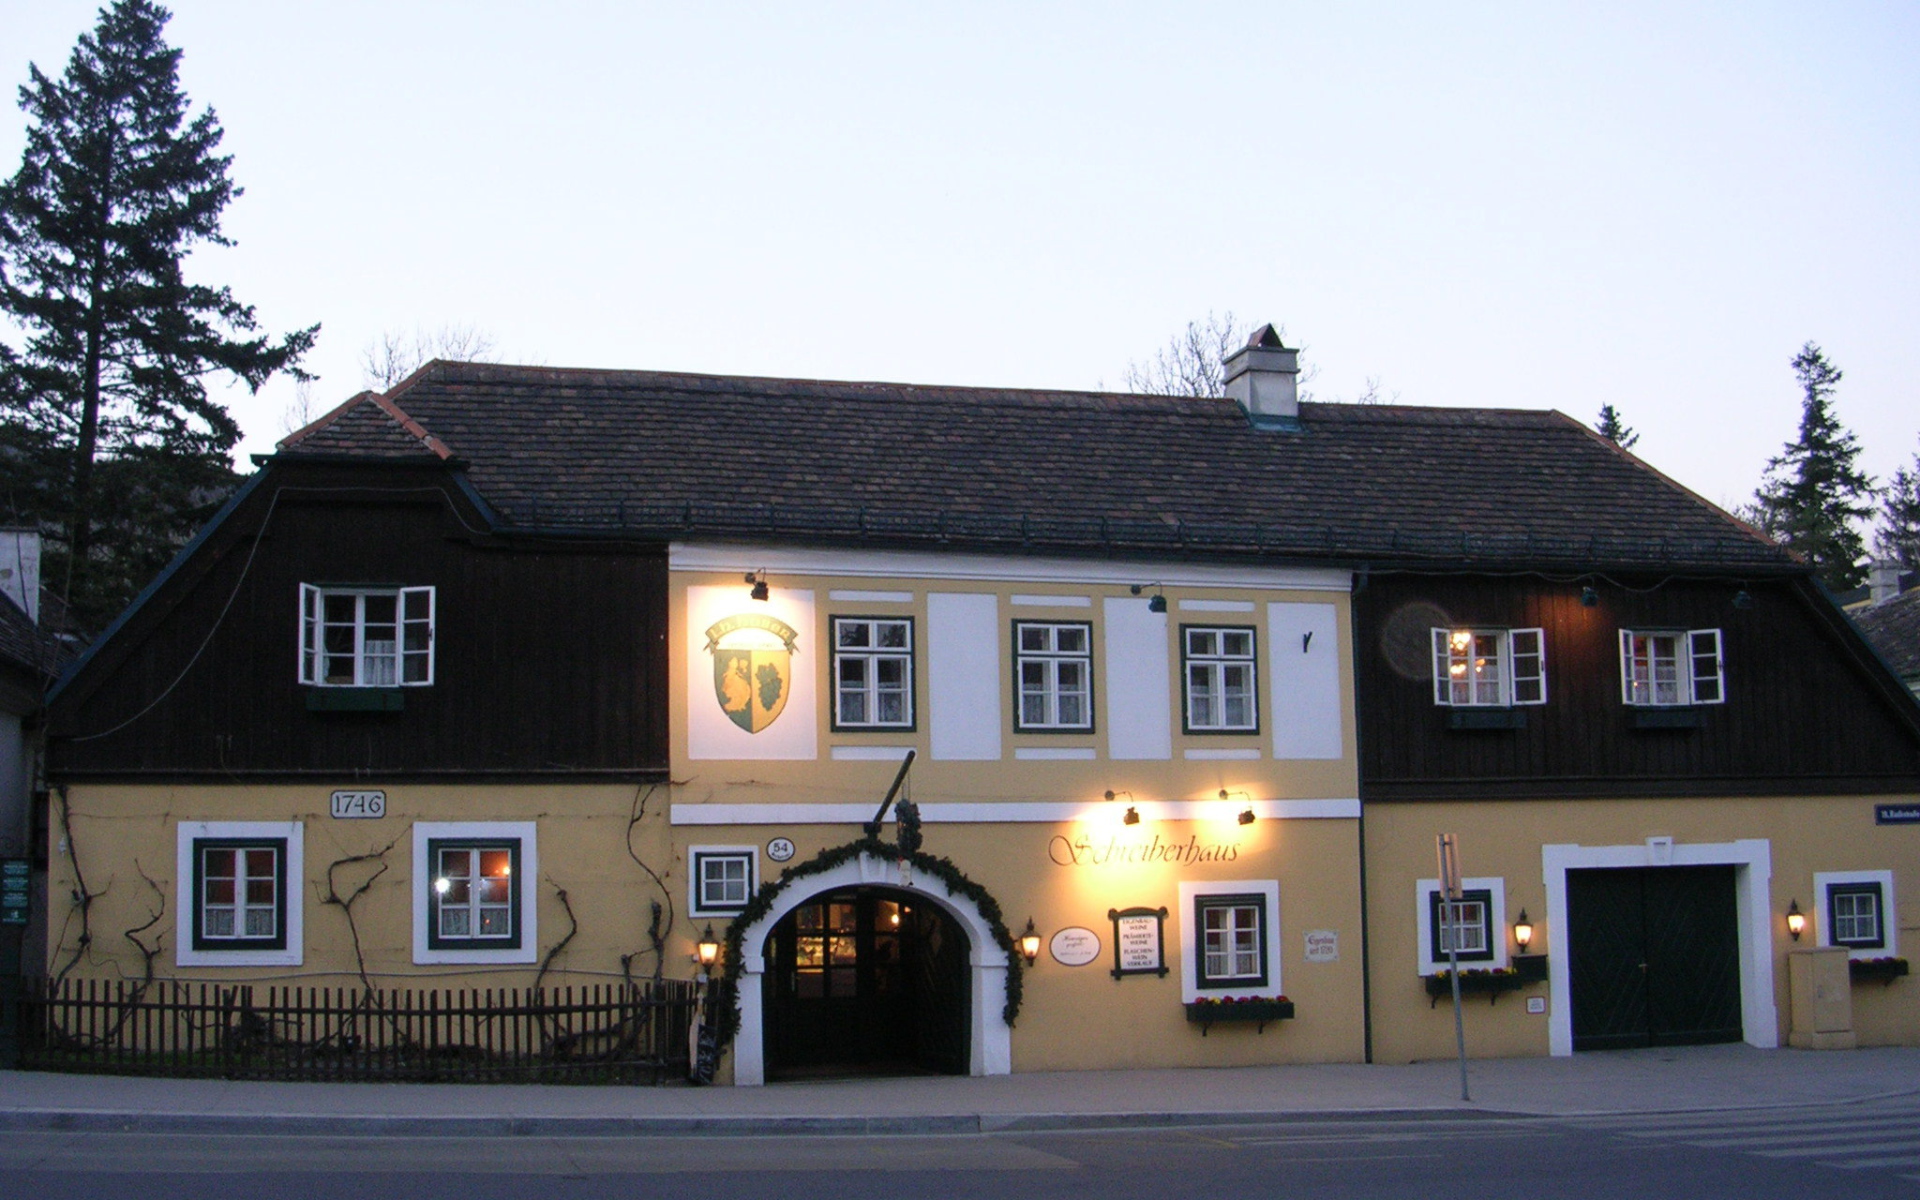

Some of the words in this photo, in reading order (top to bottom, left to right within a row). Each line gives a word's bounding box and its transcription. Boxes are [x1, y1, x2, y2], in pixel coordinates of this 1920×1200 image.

[335, 795, 381, 813] 1746
[773, 842, 788, 852] 54
[1048, 834, 1241, 867] Schreiberhaus
